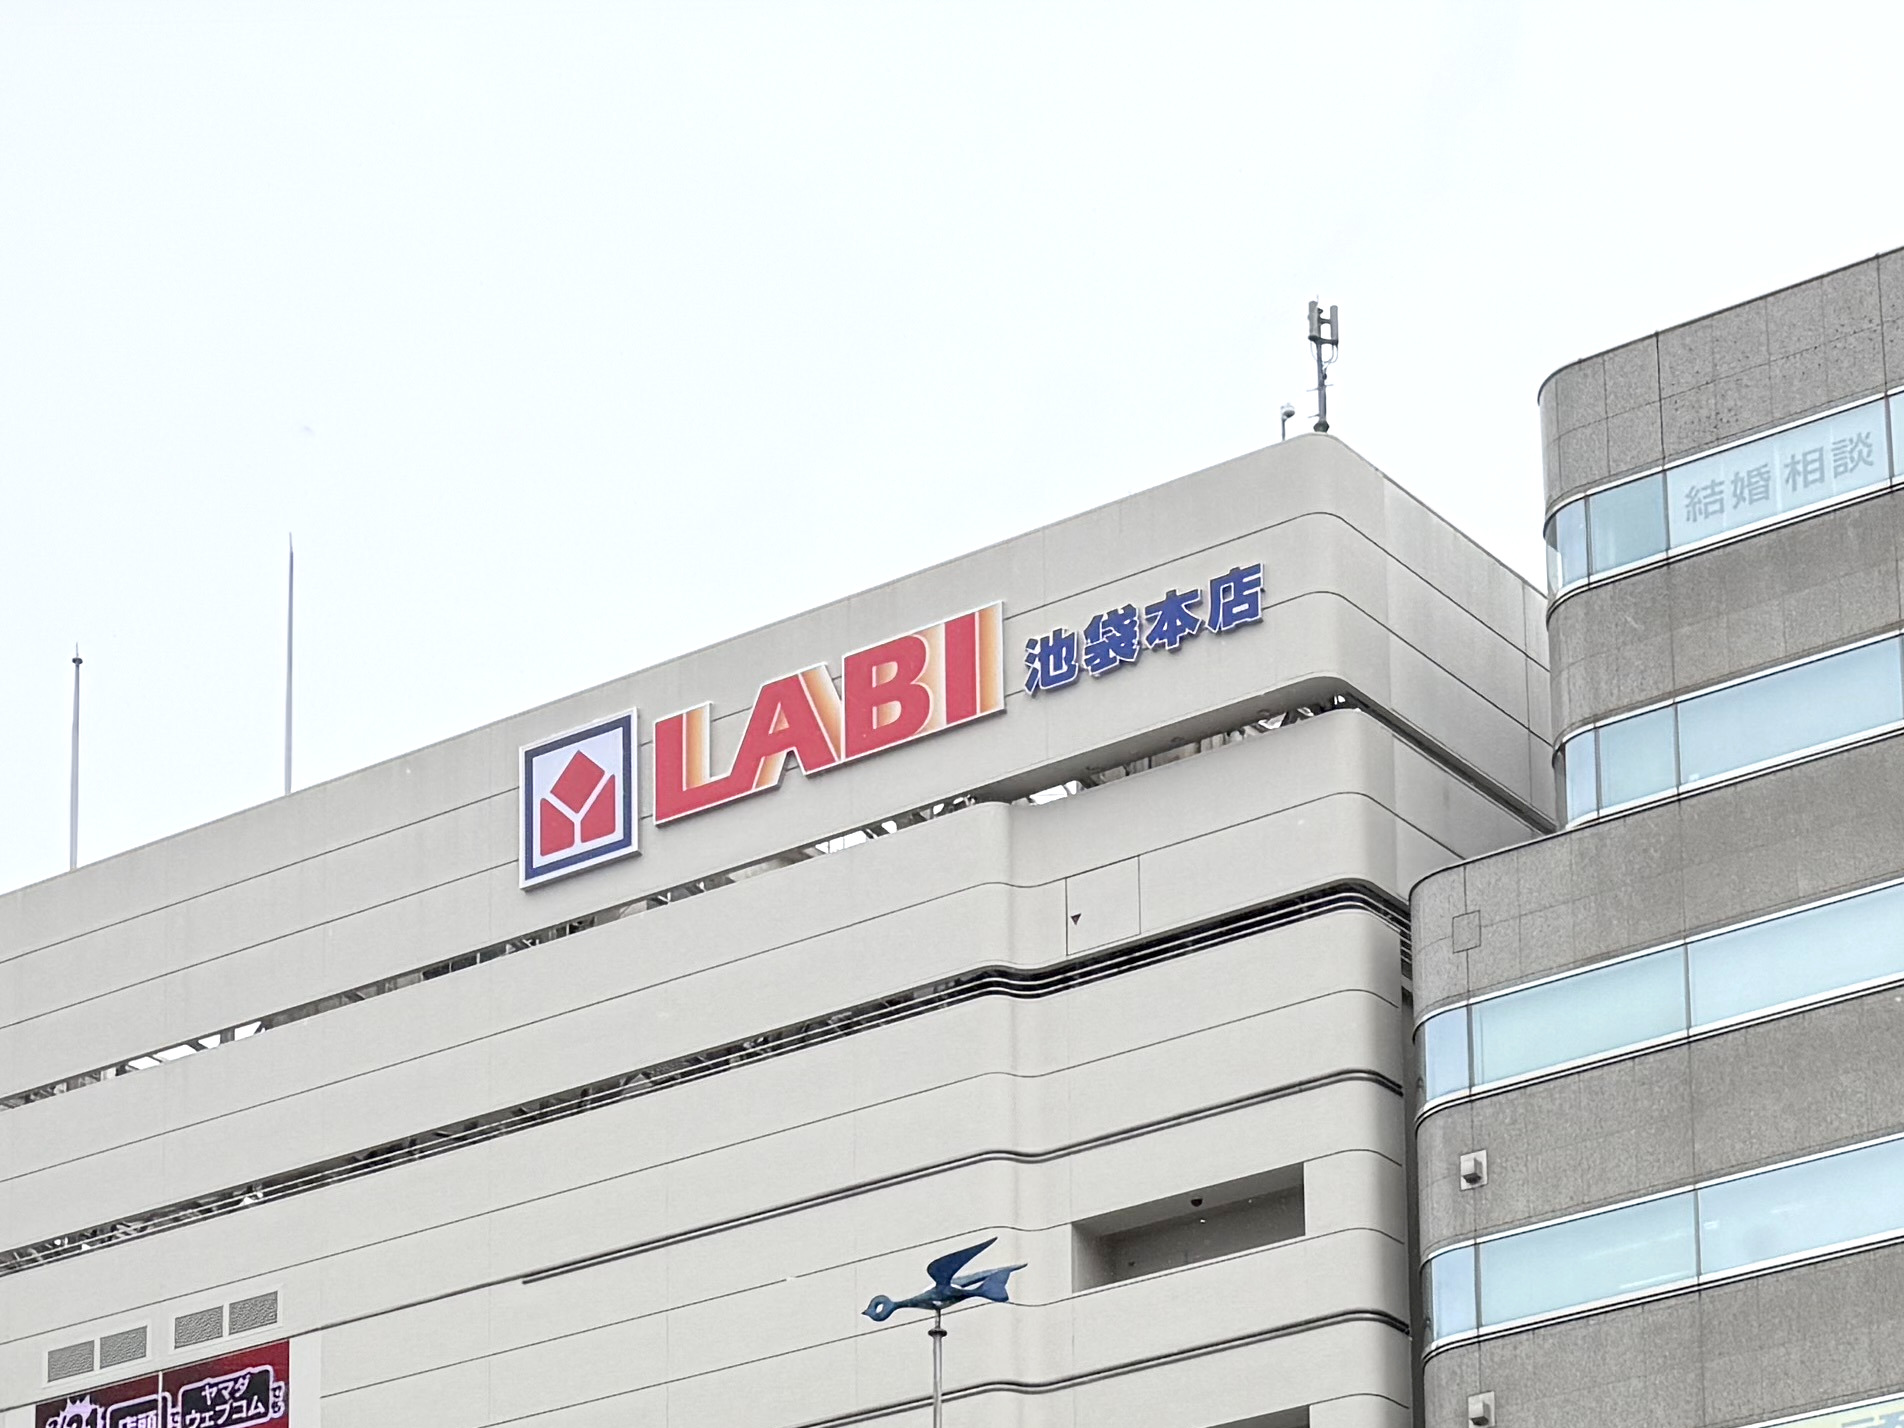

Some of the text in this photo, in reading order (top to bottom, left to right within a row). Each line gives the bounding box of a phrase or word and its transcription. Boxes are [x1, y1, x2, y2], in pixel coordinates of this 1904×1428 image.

[1684, 430, 1876, 524] 結婚相談
[1022, 563, 1265, 696] 池袋本店
[654, 601, 1006, 827] LABI
[201, 1376, 249, 1406] ヤマダ
